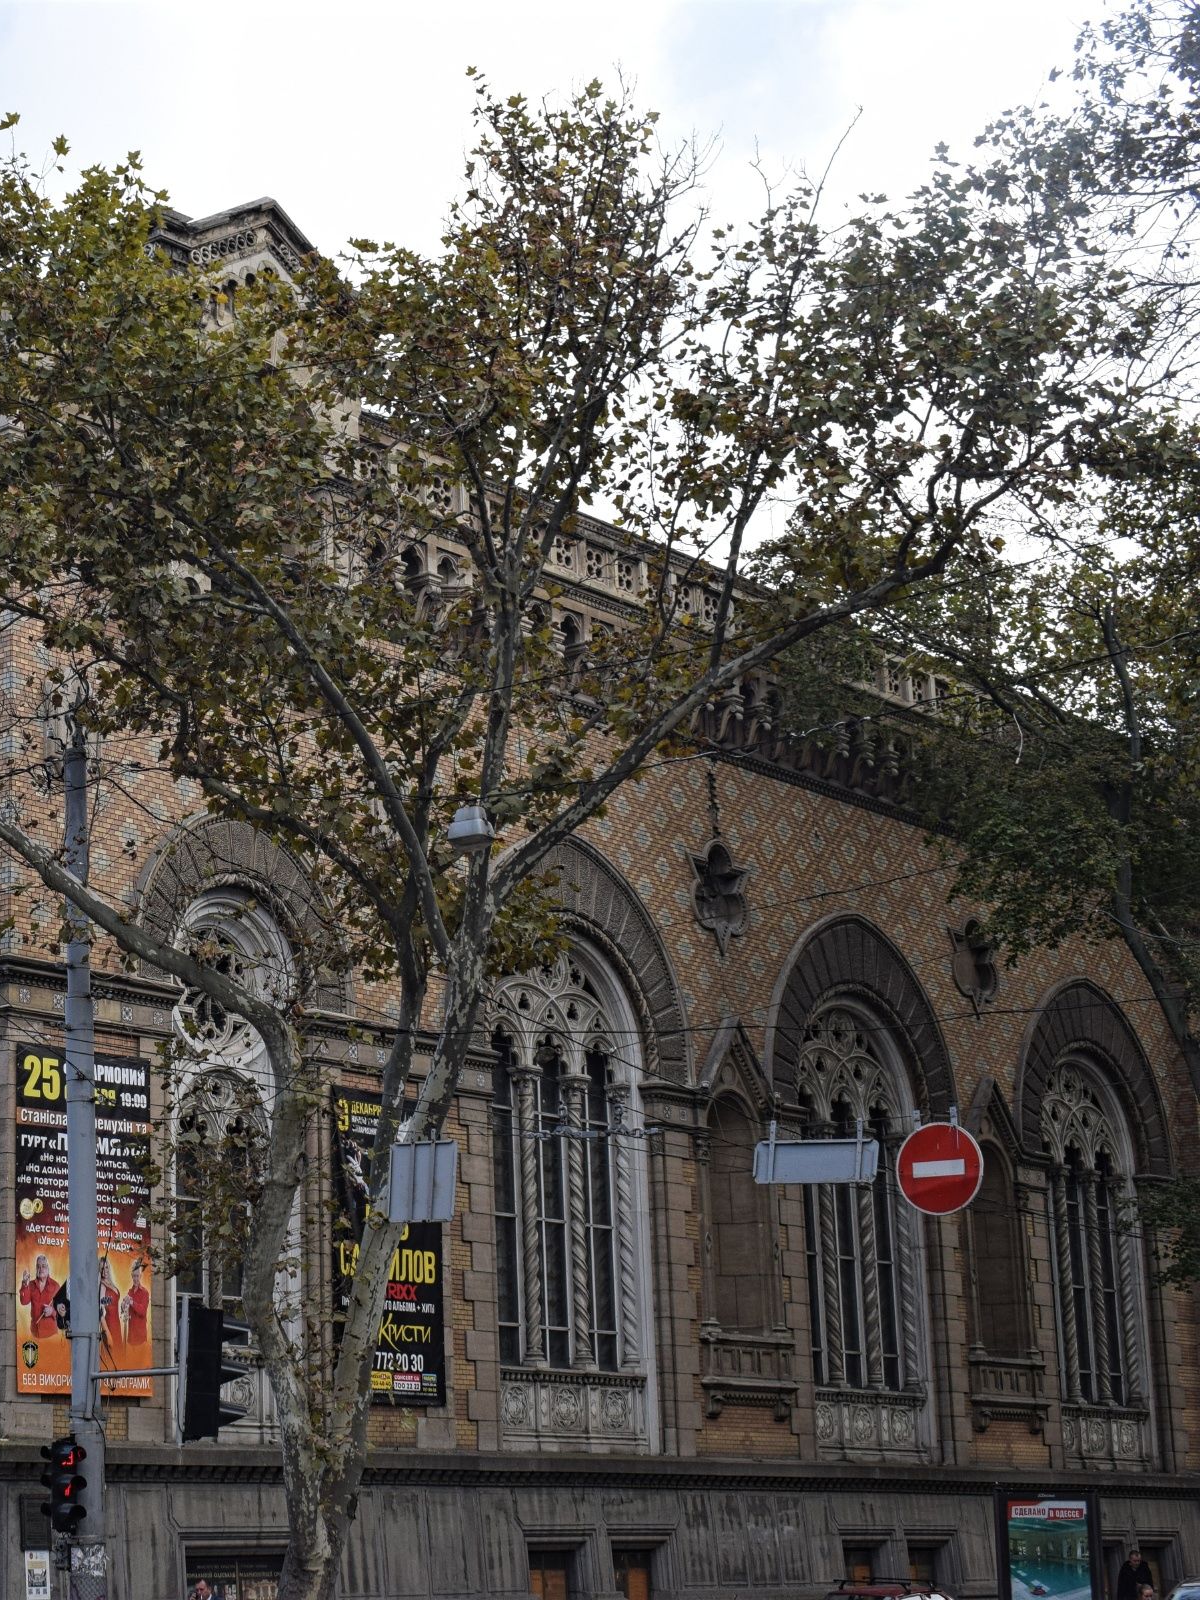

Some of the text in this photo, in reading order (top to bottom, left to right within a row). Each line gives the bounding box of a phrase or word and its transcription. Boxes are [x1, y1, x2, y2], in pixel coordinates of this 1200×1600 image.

[23, 1054, 60, 1100] 25
[120, 1092, 147, 1109] 19:00
[20, 1108, 67, 1126] Станісла
[135, 1124, 147, 1135] та
[410, 1353, 424, 1373] 30
[22, 1373, 37, 1386] БЕЗ
[1014, 1506, 1080, 1518] СДЕЛАНО В ОДЕССЕ
